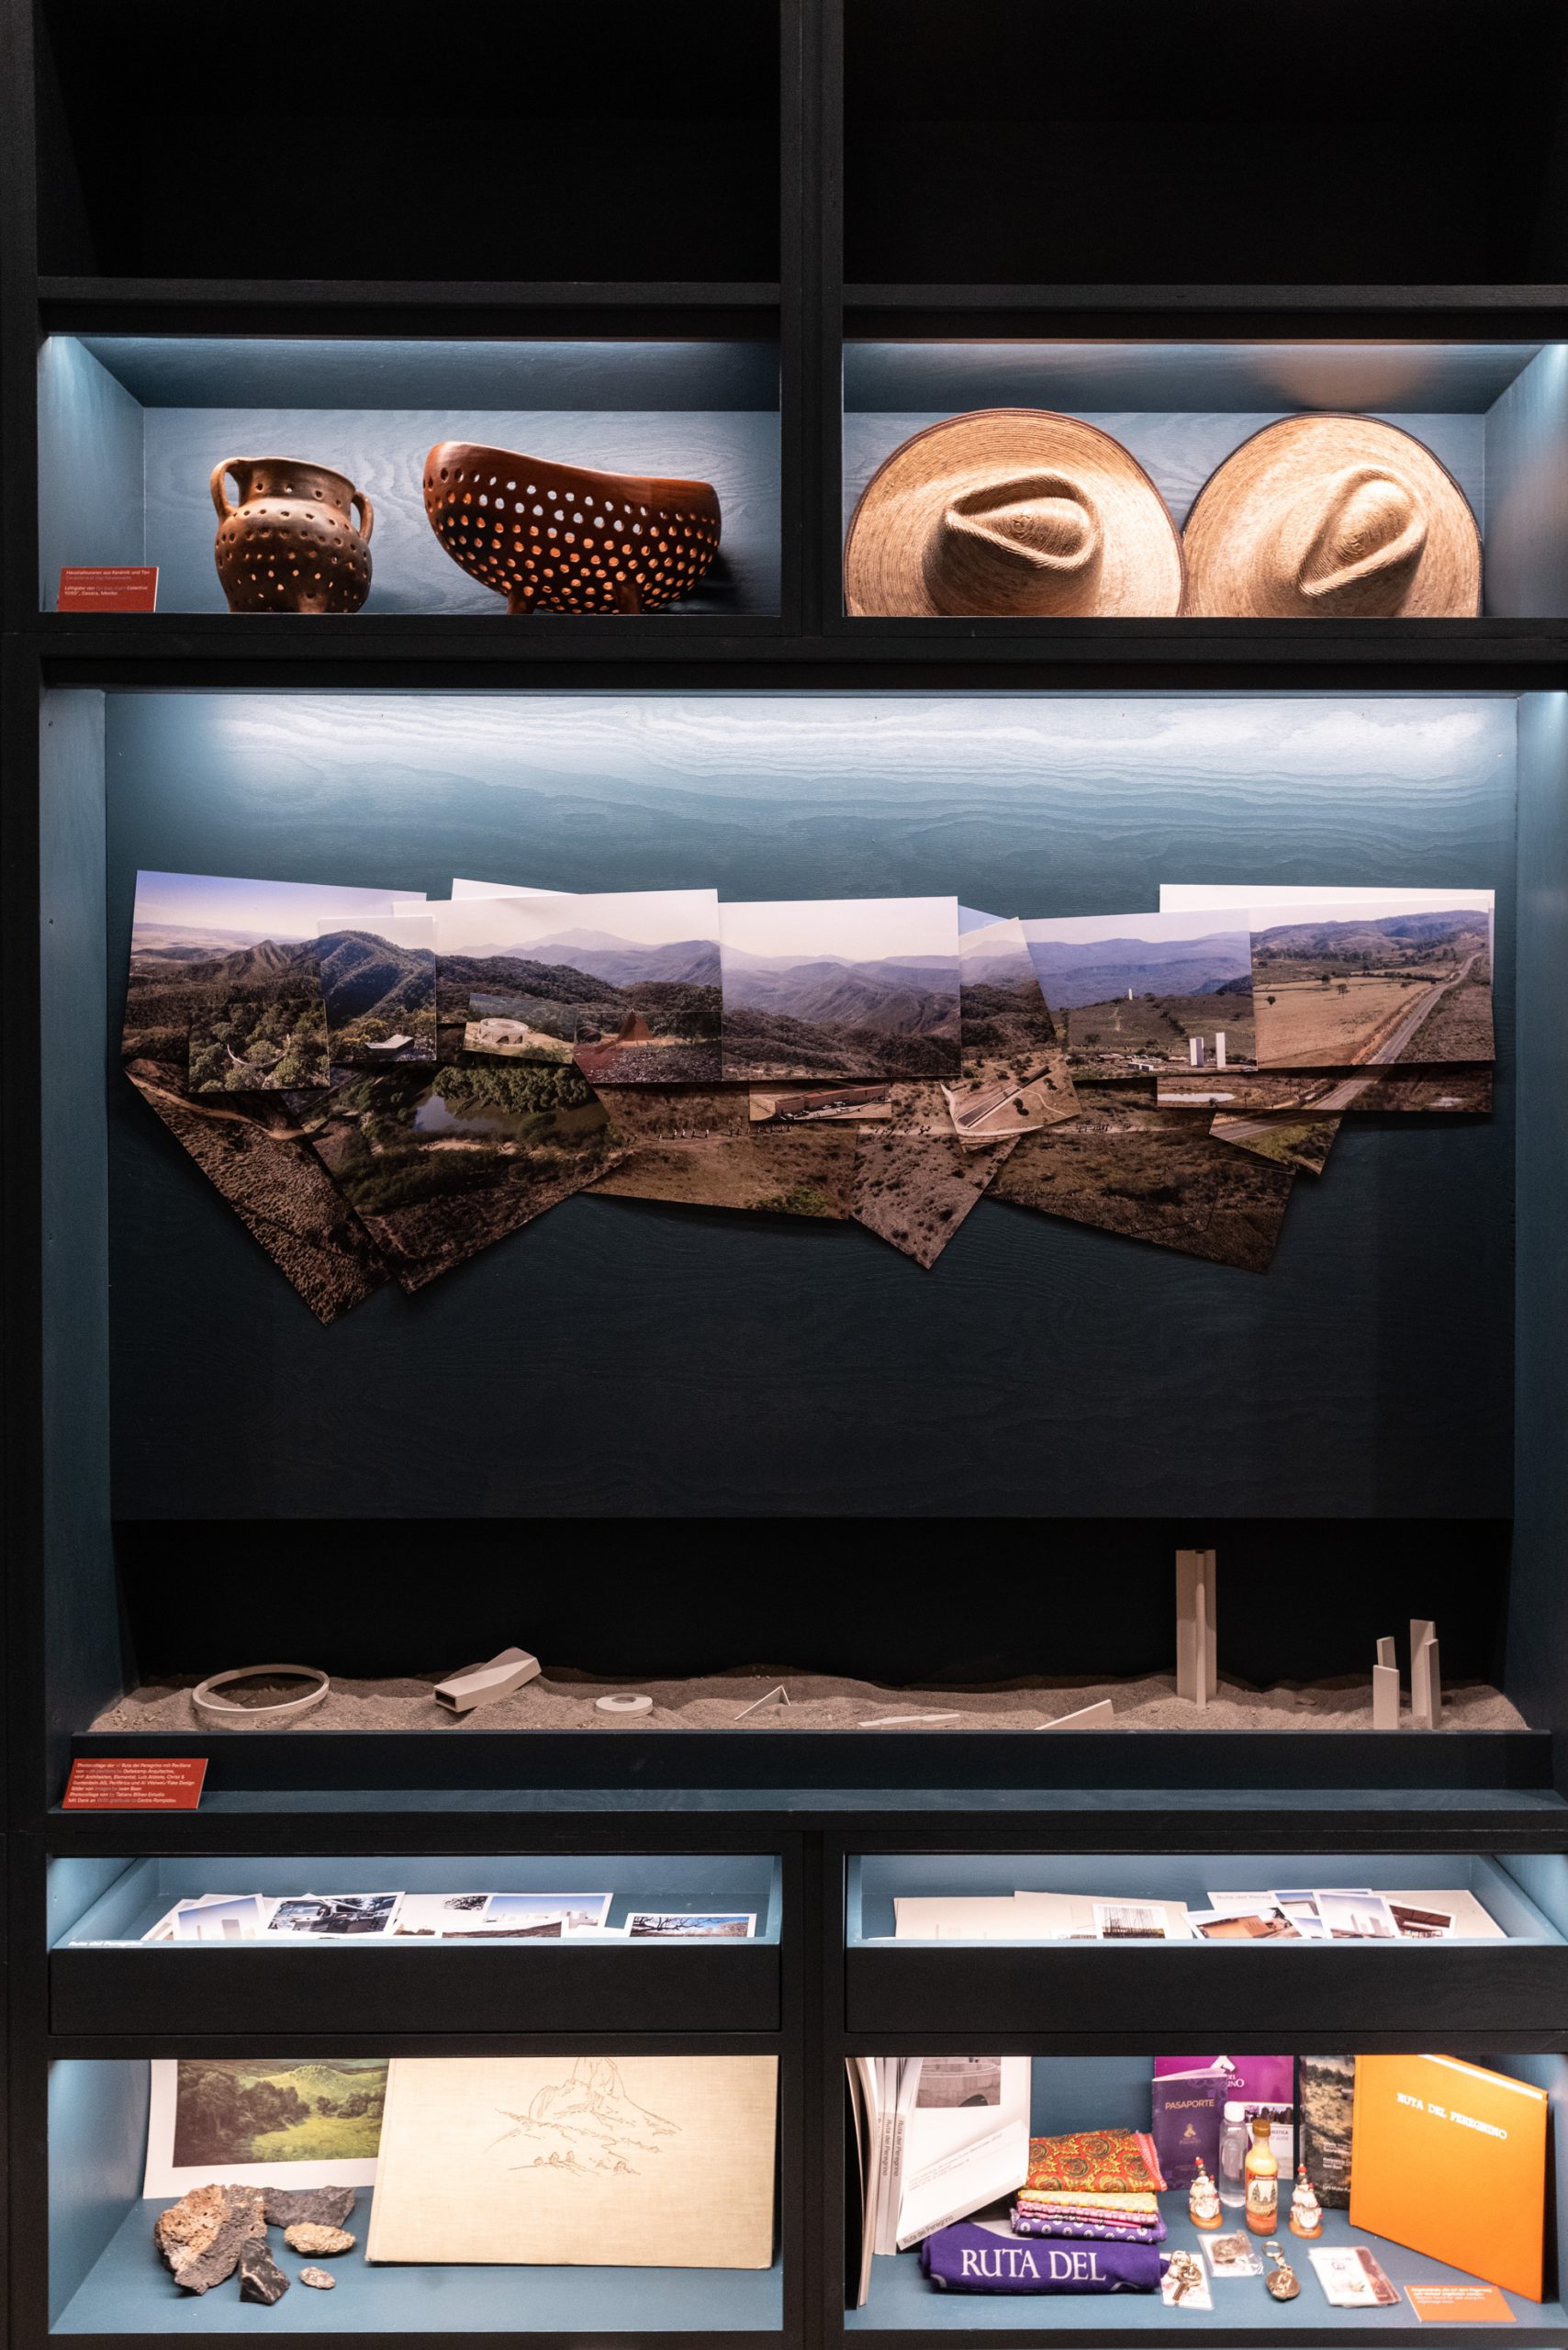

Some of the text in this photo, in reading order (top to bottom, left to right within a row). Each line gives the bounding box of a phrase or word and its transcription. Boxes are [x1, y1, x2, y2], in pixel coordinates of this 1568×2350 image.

[1165, 2098, 1215, 2110] PASAPORTE
[1396, 2092, 1507, 2140] RUTA DEL PEREGRINO
[882, 2145, 890, 2177] Peregrino
[893, 2145, 902, 2177] Peregrino
[902, 2234, 917, 2244] Ruta
[925, 2214, 954, 2232] Peregrino
[960, 2248, 1107, 2281] RUTA DEL
